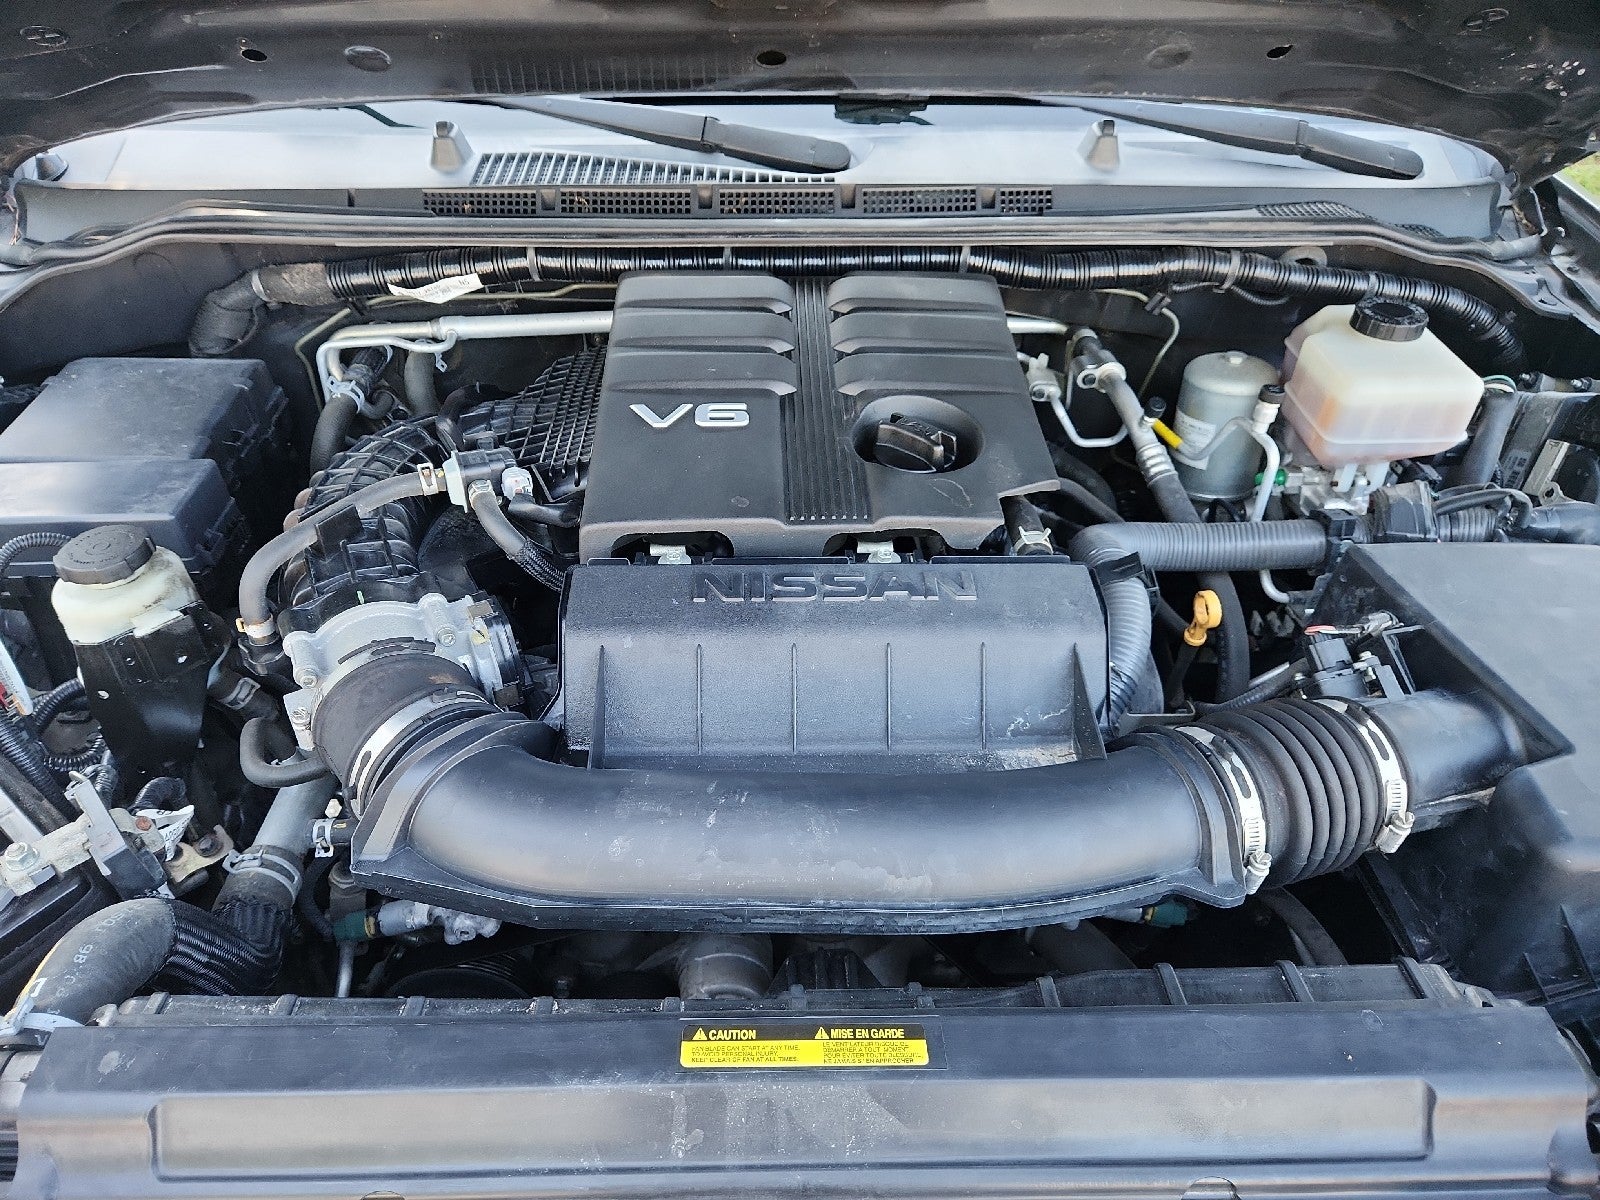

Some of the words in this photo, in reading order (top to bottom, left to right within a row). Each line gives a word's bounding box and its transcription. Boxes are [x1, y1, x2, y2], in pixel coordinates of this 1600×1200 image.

[628, 402, 750, 428] V6
[693, 571, 977, 602] NISSAN
[708, 1029, 756, 1040] CAUTION
[831, 1028, 854, 1039] MISE
[855, 1028, 869, 1039] EN
[870, 1028, 905, 1039] GARDE
